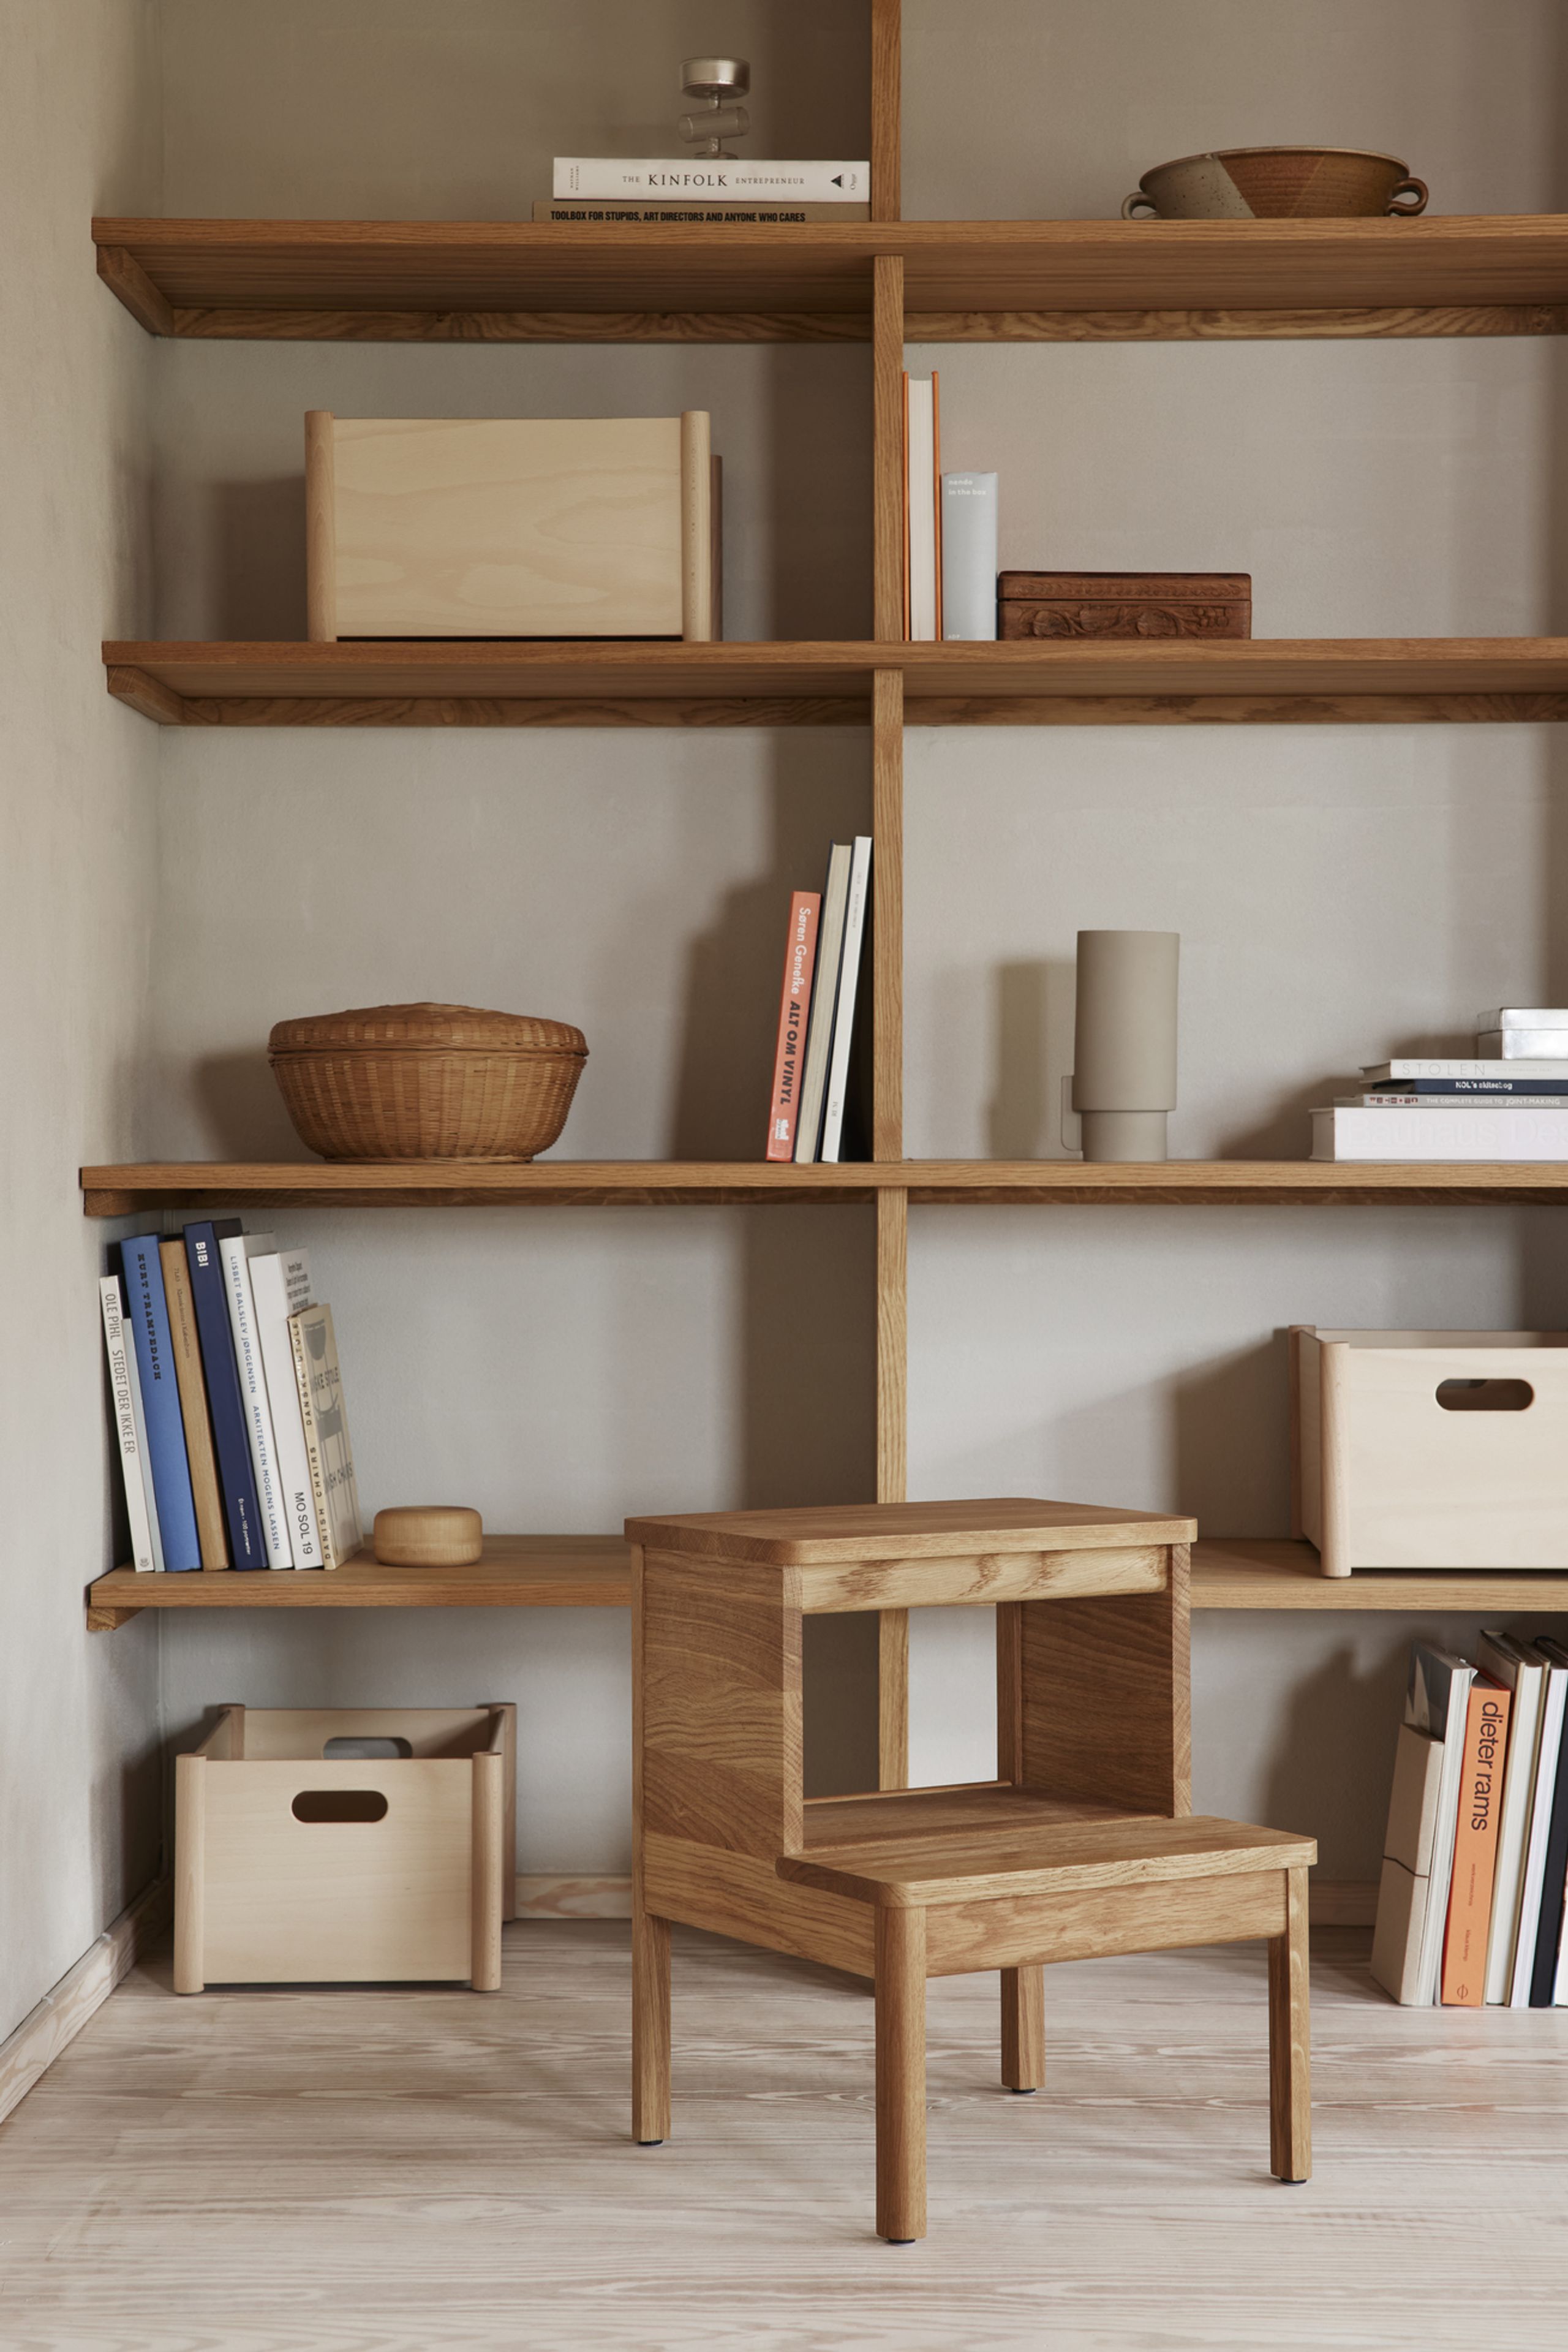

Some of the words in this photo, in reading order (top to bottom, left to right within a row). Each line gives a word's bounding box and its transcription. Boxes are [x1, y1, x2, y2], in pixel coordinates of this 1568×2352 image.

[649, 174, 728, 187] KINFOLK
[551, 210, 587, 221] TOOLBOX
[589, 211, 603, 221] FOR
[605, 211, 642, 222] STUPIDS,
[644, 212, 658, 221] ART
[660, 211, 704, 221] DIRECTORS
[706, 212, 723, 221] AND
[725, 212, 756, 221] ANYONE
[759, 213, 778, 221] WHO
[779, 213, 806, 221] CARES
[797, 907, 812, 941] Søren
[791, 944, 807, 995] Genefke
[789, 1000, 801, 1027] ALT
[785, 1029, 798, 1055] OM
[780, 1060, 795, 1105] VINYL
[1402, 1063, 1485, 1075] STOLEN
[1505, 1097, 1561, 1106] JOINT-MAKING
[1346, 1113, 1498, 1144] Bauhaus
[195, 1241, 209, 1267] BIBI
[230, 1255, 242, 1288] LISBET
[105, 1293, 117, 1312] OLE
[138, 1254, 148, 1288] KURT
[143, 1293, 162, 1381] TRAMPEDACH
[236, 1292, 247, 1334] BALSLEV
[108, 1315, 121, 1340] PIHL
[112, 1349, 127, 1386] STEDET
[241, 1336, 257, 1394] JØRGENSEN
[117, 1388, 130, 1411] DER
[120, 1413, 134, 1439] IKKE
[252, 1405, 268, 1466] ARKITEKTEN
[124, 1440, 135, 1454] ER
[311, 1446, 323, 1498] CHAIRS
[263, 1469, 274, 1510] MOGENS
[294, 1491, 306, 1513] MO
[266, 1513, 281, 1550] LASSEN
[296, 1515, 310, 1540] SOL
[318, 1507, 331, 1560] DANISH
[301, 1542, 313, 1555] 19
[1477, 1701, 1504, 1769] dieter
[1472, 1774, 1491, 1831] rams
